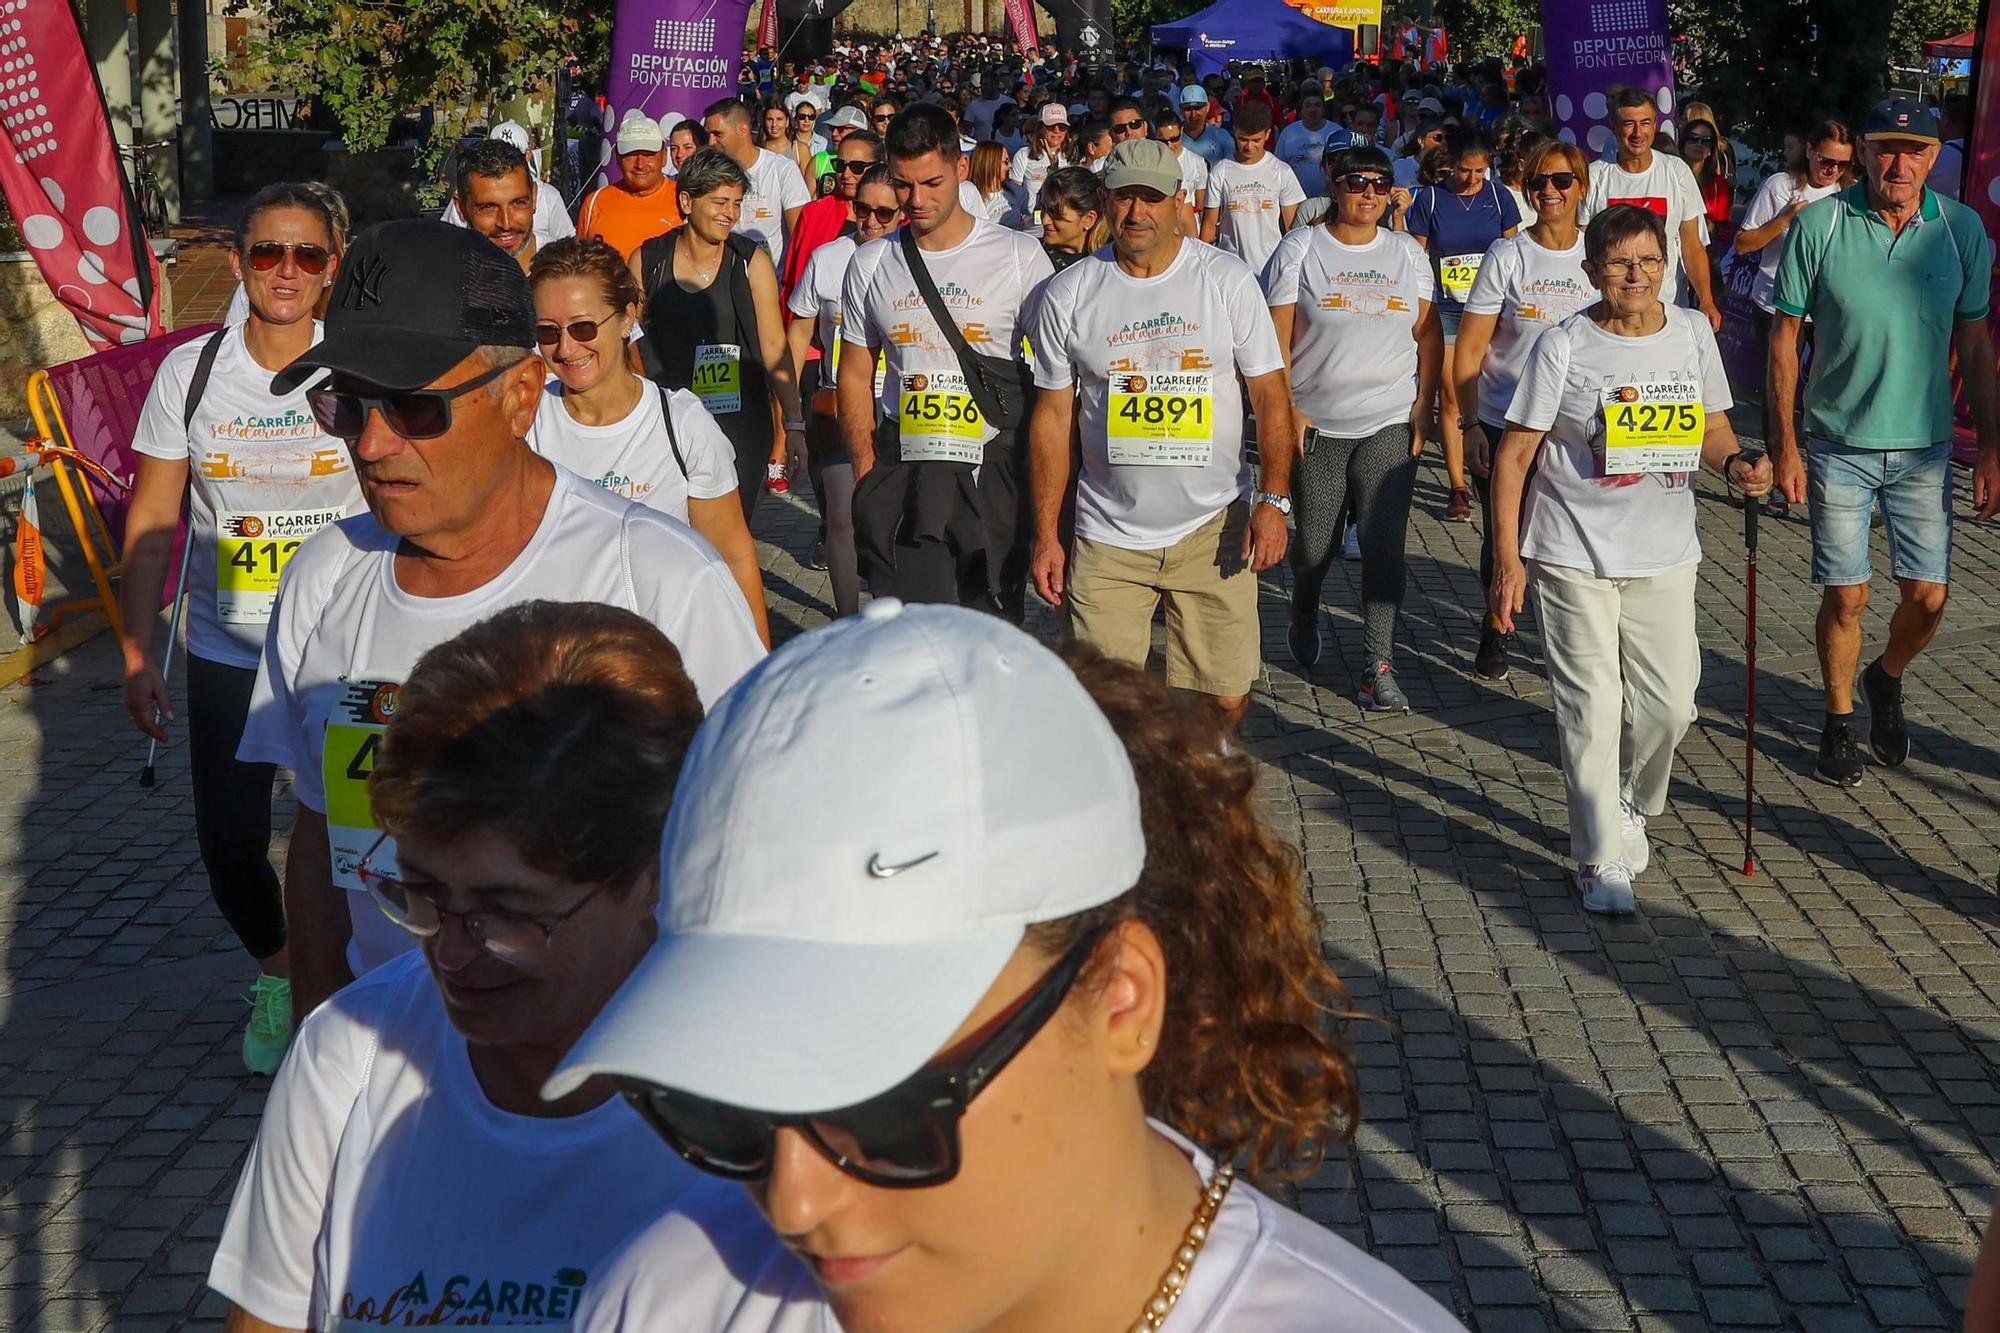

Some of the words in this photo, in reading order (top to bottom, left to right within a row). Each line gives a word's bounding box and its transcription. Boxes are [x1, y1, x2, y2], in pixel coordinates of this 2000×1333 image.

[1573, 30, 1665, 55] DEPUTACIÓN
[631, 53, 729, 74] DEPUTACIÓN
[1575, 50, 1667, 69] PONTEVEDRA
[630, 69, 728, 89] PONTEVEDRA
[1347, 271, 1387, 279] CARREIRA
[1544, 279, 1582, 291] CARREIRA
[1123, 324, 1130, 333] A
[1132, 315, 1183, 330] CARREIRA
[1106, 325, 1162, 347] solidaria
[704, 347, 737, 355] ARREIRA
[1156, 375, 1208, 385] CARREIRA
[1645, 384, 1696, 394] CARREIRA
[904, 394, 978, 424] 4556
[1119, 396, 1203, 425] 4891
[1616, 404, 1697, 432] 4275
[209, 417, 287, 439] solidaria
[233, 415, 244, 426] A
[247, 413, 314, 429] CARREIRA
[275, 511, 341, 528] CARREIRA
[400, 1270, 429, 1305] A
